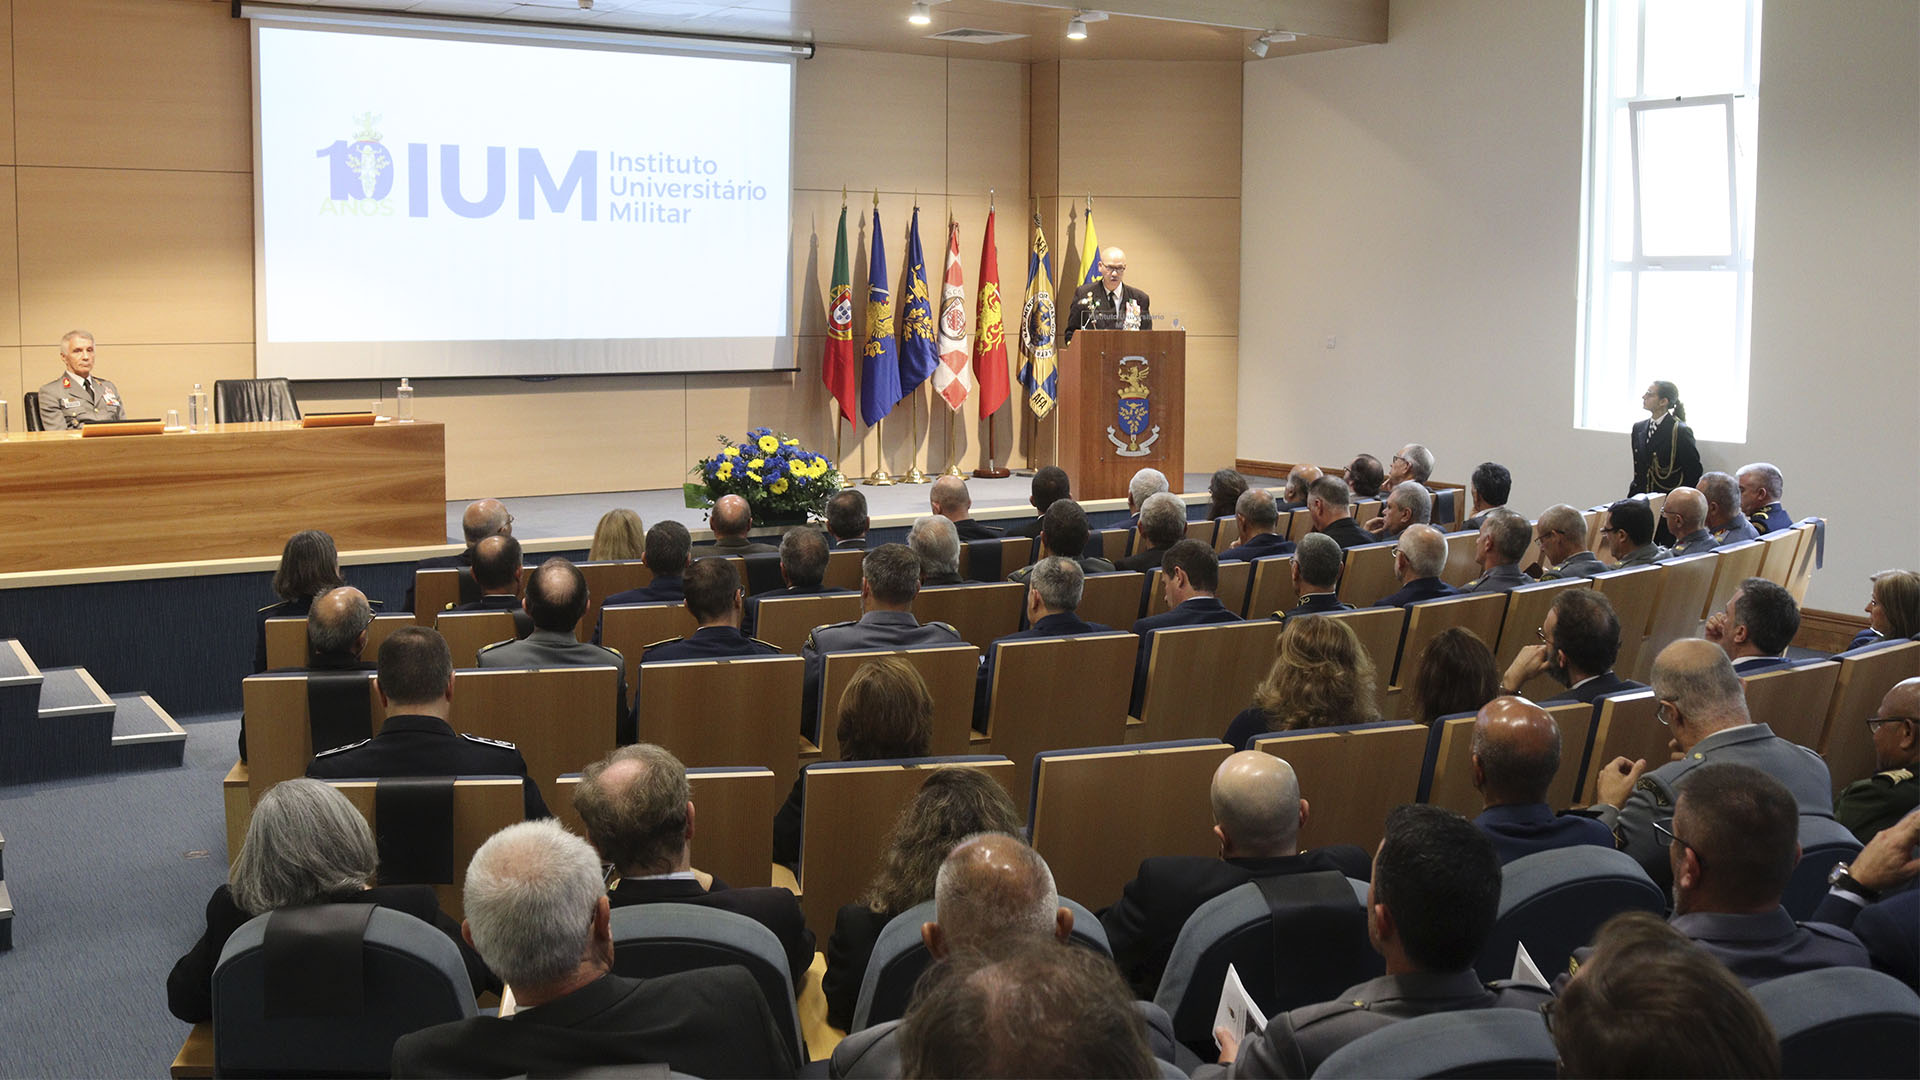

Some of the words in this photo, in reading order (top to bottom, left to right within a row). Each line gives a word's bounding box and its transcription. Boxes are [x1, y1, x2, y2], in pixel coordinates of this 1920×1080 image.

[316, 139, 394, 201] 10
[610, 152, 718, 175] Instituto
[408, 143, 598, 222] IUM
[610, 176, 767, 202] Universitário
[319, 197, 395, 216] ANOS
[610, 203, 692, 224] Militar
[1031, 393, 1048, 410] AFA
